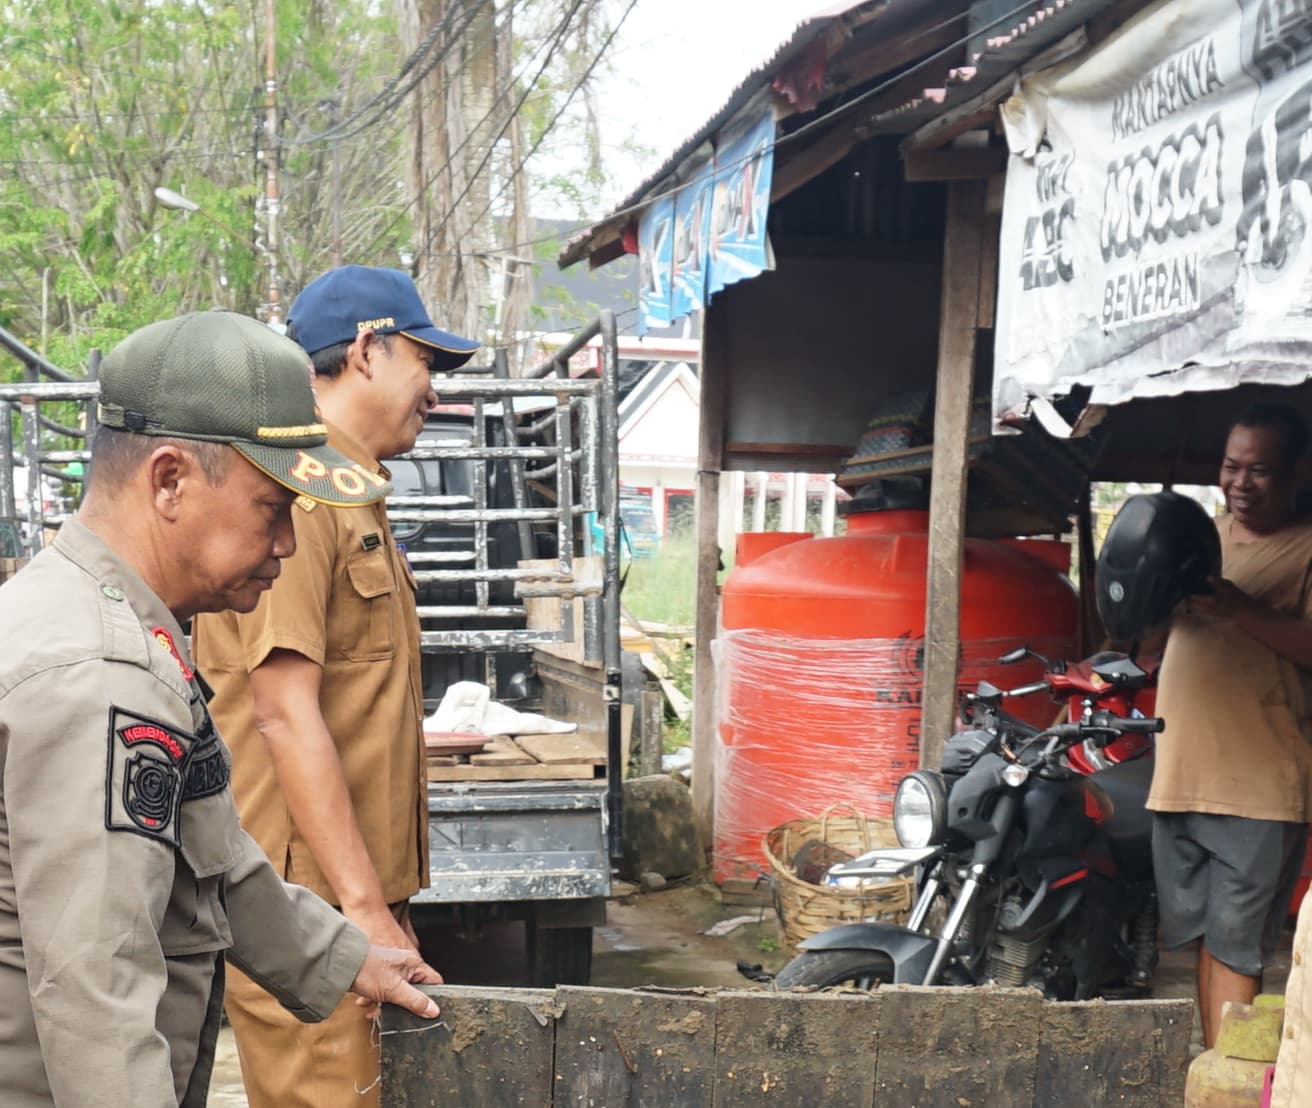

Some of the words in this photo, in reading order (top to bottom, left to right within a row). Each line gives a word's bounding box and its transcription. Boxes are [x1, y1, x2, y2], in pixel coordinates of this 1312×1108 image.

[1112, 37, 1225, 144] MANTAPNYA
[1102, 113, 1224, 262] MOCCA
[1019, 198, 1075, 291] ABC
[1102, 253, 1199, 326] BENERAN
